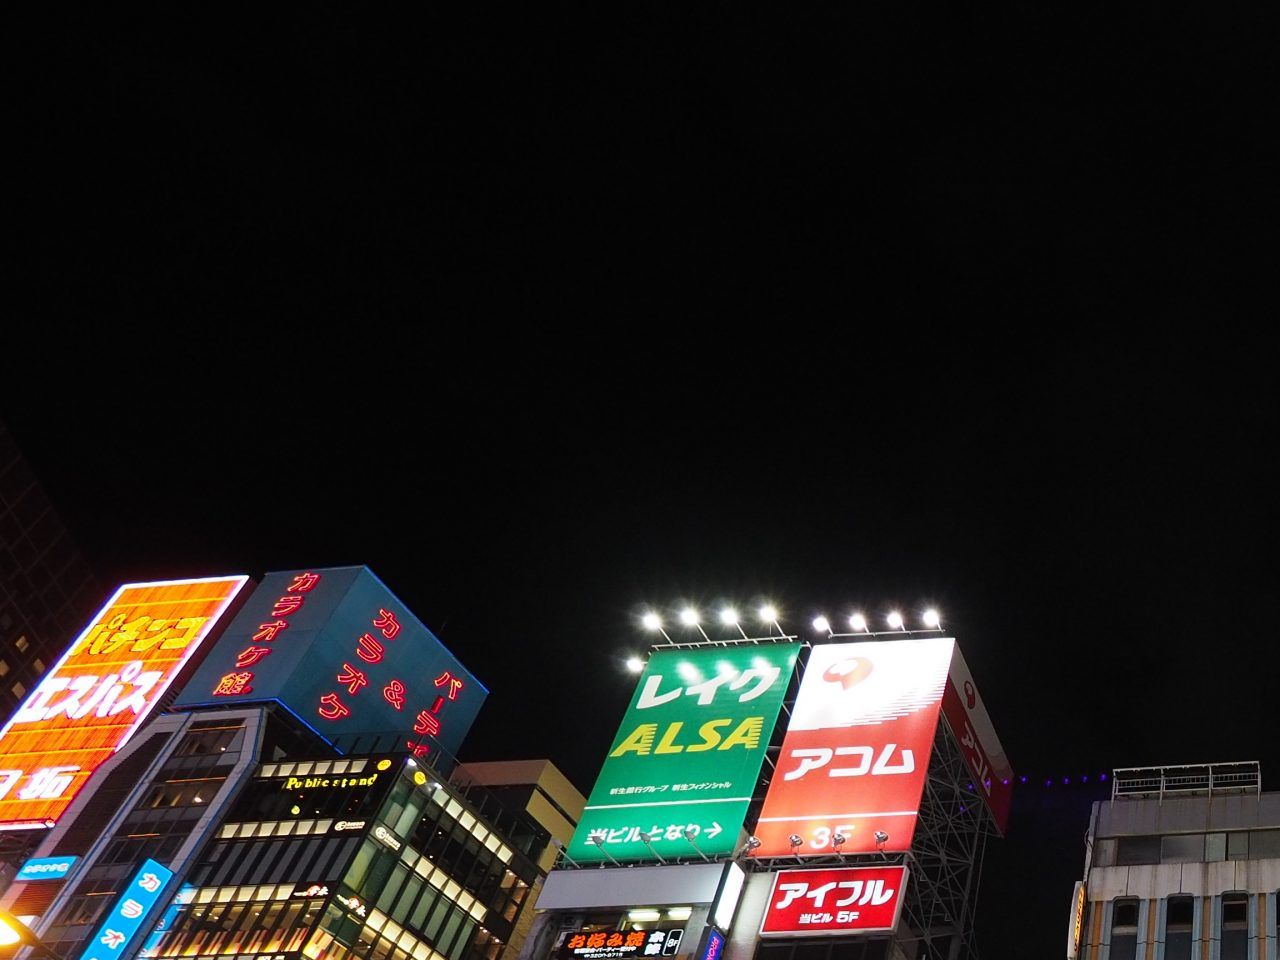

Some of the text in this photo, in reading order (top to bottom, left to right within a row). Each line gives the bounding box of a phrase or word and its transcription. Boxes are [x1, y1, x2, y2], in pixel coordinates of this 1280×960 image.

[70, 612, 211, 656] パチンコ
[213, 572, 320, 696] カラオケ館
[318, 608, 402, 720] カラオケ
[384, 681, 406, 709] &
[14, 660, 162, 722] エスパス
[636, 667, 781, 709] レイク
[609, 717, 763, 757] ALSA
[784, 744, 914, 780] アコム
[584, 824, 692, 845] 当ビルとなり
[809, 824, 855, 849] 3F
[776, 879, 895, 908] アイフル
[799, 911, 859, 925] 当ビル 5F
[568, 932, 646, 948] お好み焼
